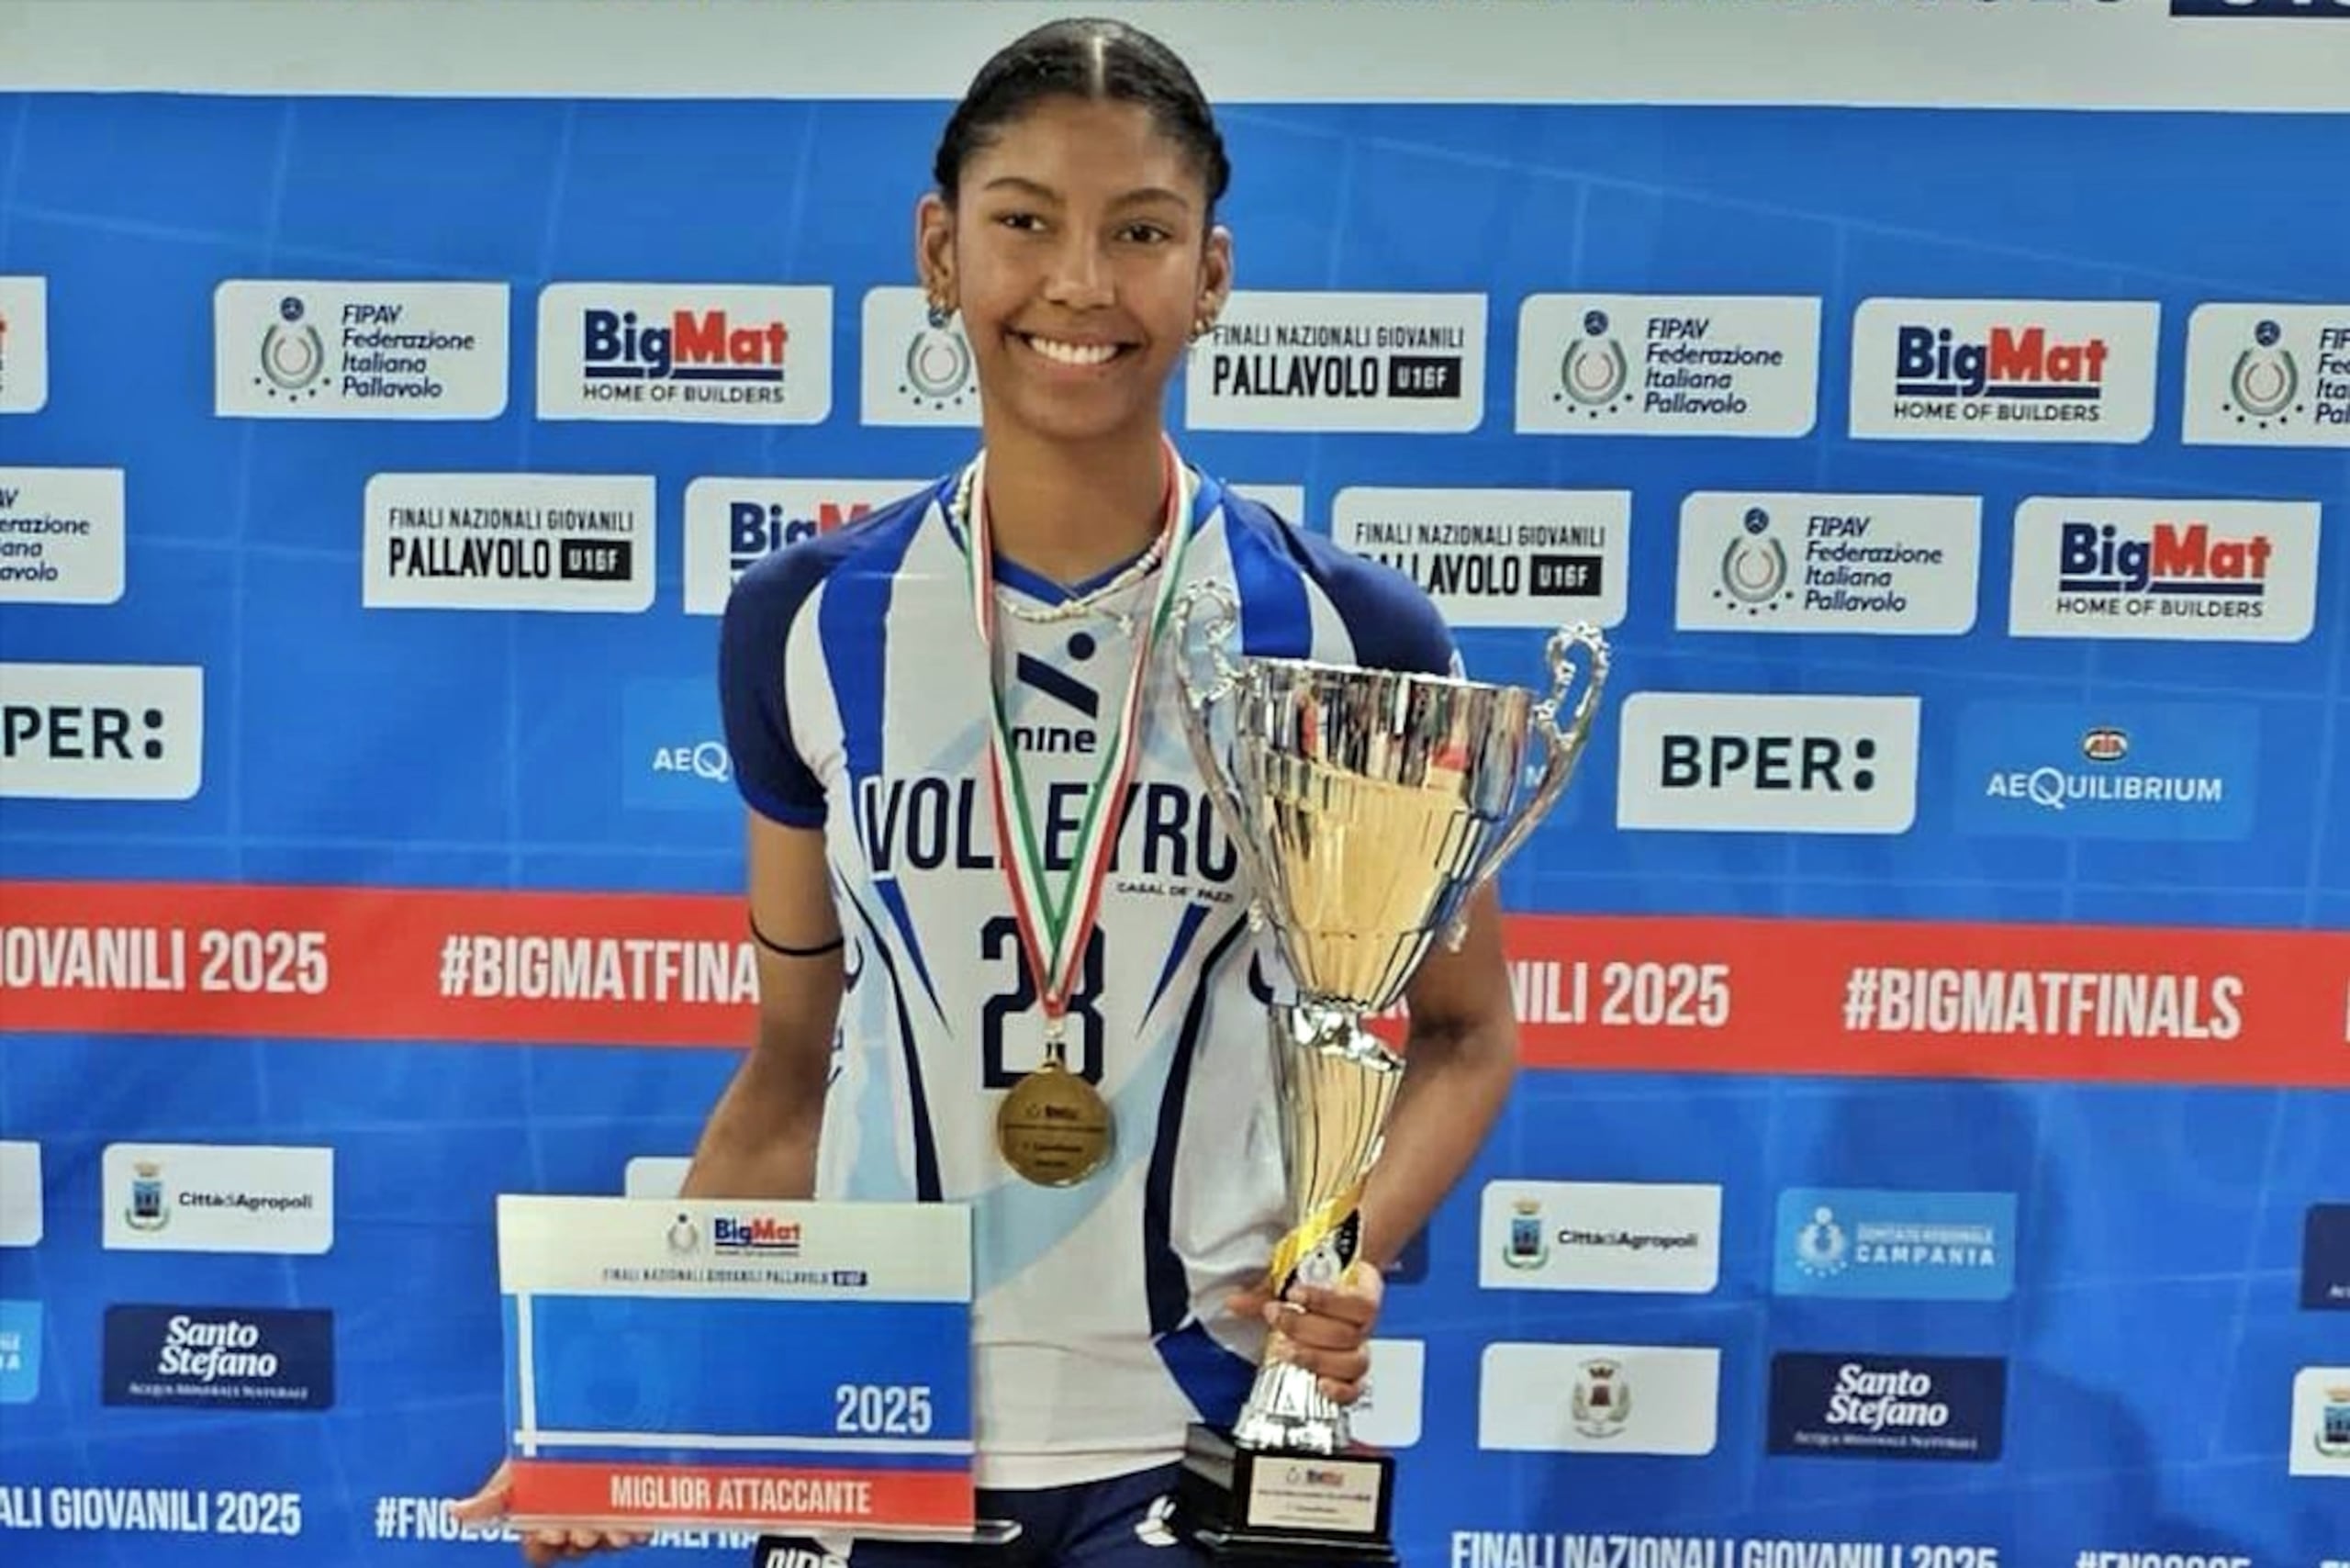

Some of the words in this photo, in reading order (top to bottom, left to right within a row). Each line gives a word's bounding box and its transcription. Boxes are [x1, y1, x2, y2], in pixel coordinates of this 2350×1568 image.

[341, 305, 402, 323] FIPAV
[341, 329, 476, 351] Federazione
[1213, 324, 1270, 349] FINALI
[1276, 326, 1371, 350] NAZIONALI
[1376, 327, 1465, 351] GIOVANILI
[1646, 318, 1710, 340] FIPAV
[584, 309, 789, 379] BigMat
[1645, 342, 1784, 365] Federazione
[341, 352, 427, 374] Italiana
[1897, 326, 2109, 397] BigMat
[341, 375, 442, 398] Pallavolo
[1213, 354, 1378, 398] PALLAVOLO
[1644, 368, 1732, 389] Italiana
[583, 384, 643, 402] HOME
[650, 385, 677, 402] OF
[684, 386, 785, 404] BUILDERS
[1643, 392, 1747, 414] Pallavolo
[1894, 402, 1956, 420] HOME
[1963, 403, 1990, 421] OF
[1997, 404, 2100, 422] BUILDERS
[389, 508, 443, 529] FINALI
[450, 509, 542, 530] NAZIONALI
[547, 510, 633, 532] GIOVANILI
[1807, 516, 1871, 538] FIPAV
[1356, 521, 1411, 544] FINALI
[1418, 523, 1513, 546] NAZIONALI
[1518, 525, 1606, 548] GIOVANILI
[389, 537, 551, 577] PALLAVOLO
[1805, 541, 1943, 564] Federazione
[2059, 522, 2272, 592] BigMat
[1804, 566, 1893, 588] Italiana
[1803, 590, 1908, 612] Pallavolo
[2057, 598, 2120, 616] HOME
[2125, 599, 2154, 616] OF
[2160, 599, 2263, 618] BUILDERS
[1013, 727, 1097, 754] nine
[1986, 767, 2223, 810] AEQUILIBRIUM
[1117, 882, 1165, 895] CASAL
[198, 930, 329, 993] 2025
[1602, 964, 1729, 1026] 2025
[1844, 968, 2242, 1038] #BIGMATFINALS
[714, 1218, 801, 1247] BigMat
[1856, 1245, 1996, 1267] CAMPANIA
[166, 1316, 258, 1350] Santo
[159, 1345, 276, 1381] Stefano
[1836, 1364, 1930, 1397] Santo
[835, 1384, 933, 1434] 2025
[1826, 1394, 1949, 1432] Stefano
[610, 1474, 712, 1511] MIGLIOR
[717, 1477, 871, 1513] ATTACCANTE
[50, 1488, 207, 1531] GIOVANILI
[217, 1491, 302, 1535] 2025
[1452, 1531, 1555, 1568] FINALI
